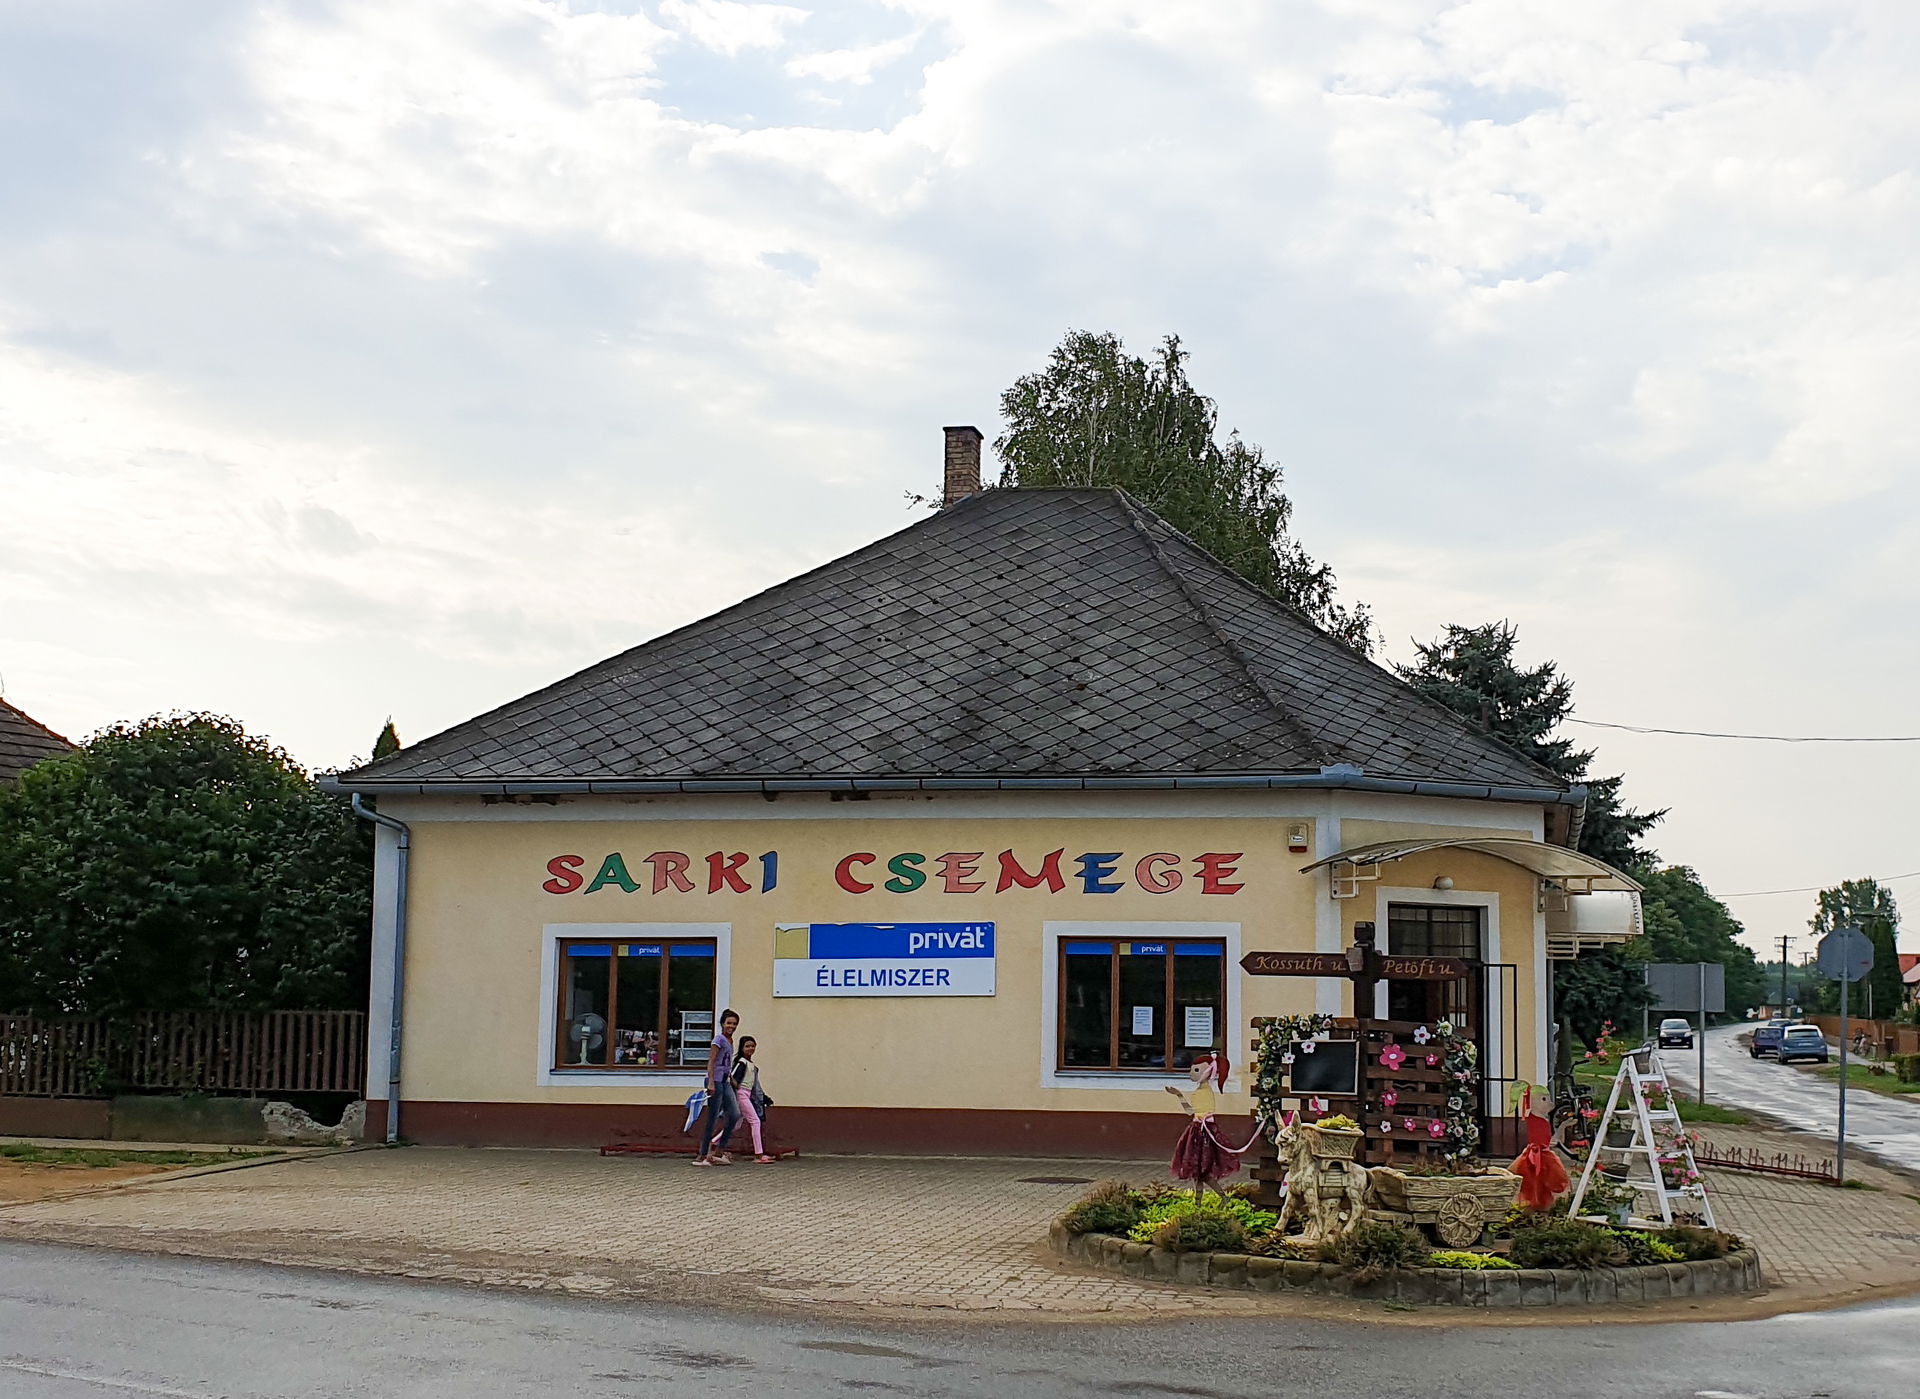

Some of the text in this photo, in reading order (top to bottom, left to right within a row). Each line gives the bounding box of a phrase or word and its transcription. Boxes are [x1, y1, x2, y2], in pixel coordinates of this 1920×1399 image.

[543, 848, 1246, 895] SARKI CSEMEGE
[909, 926, 985, 954] privát
[1254, 956, 1323, 970] Kossuth
[816, 965, 950, 987] ÉLELMISZER
